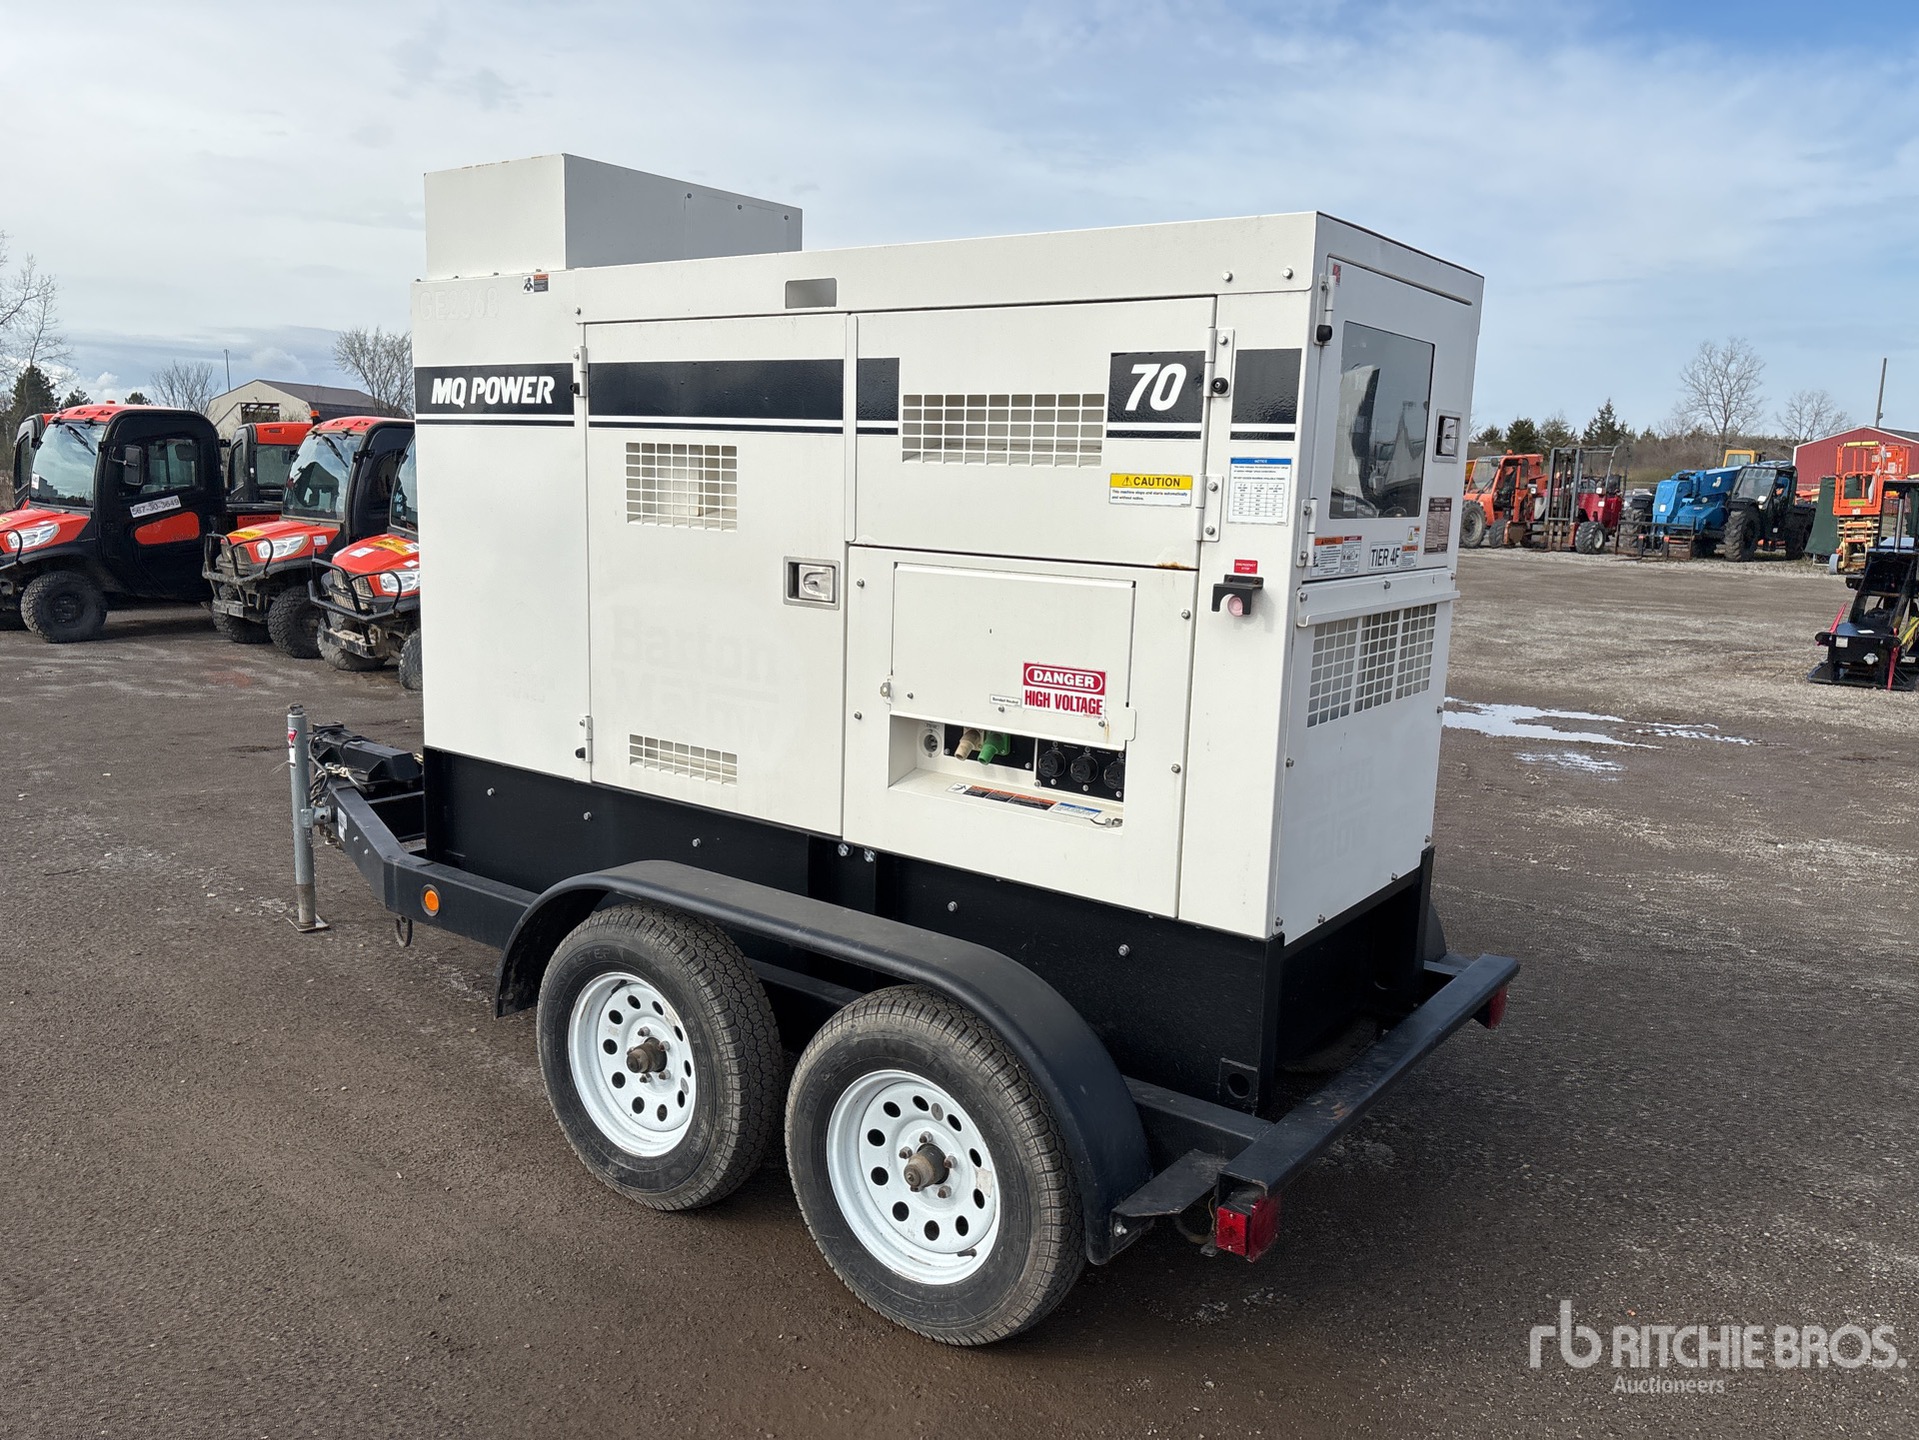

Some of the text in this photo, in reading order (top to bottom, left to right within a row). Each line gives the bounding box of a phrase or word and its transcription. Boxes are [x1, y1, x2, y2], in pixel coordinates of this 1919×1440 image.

[431, 375, 556, 409] MQ POWER
[1125, 363, 1187, 412] 70
[1133, 476, 1181, 487] CAUTION
[1371, 548, 1389, 567] TIER
[1390, 547, 1401, 565] 4F
[1033, 669, 1095, 688] DANGER
[1024, 689, 1103, 715] HIGH VOLTAGE
